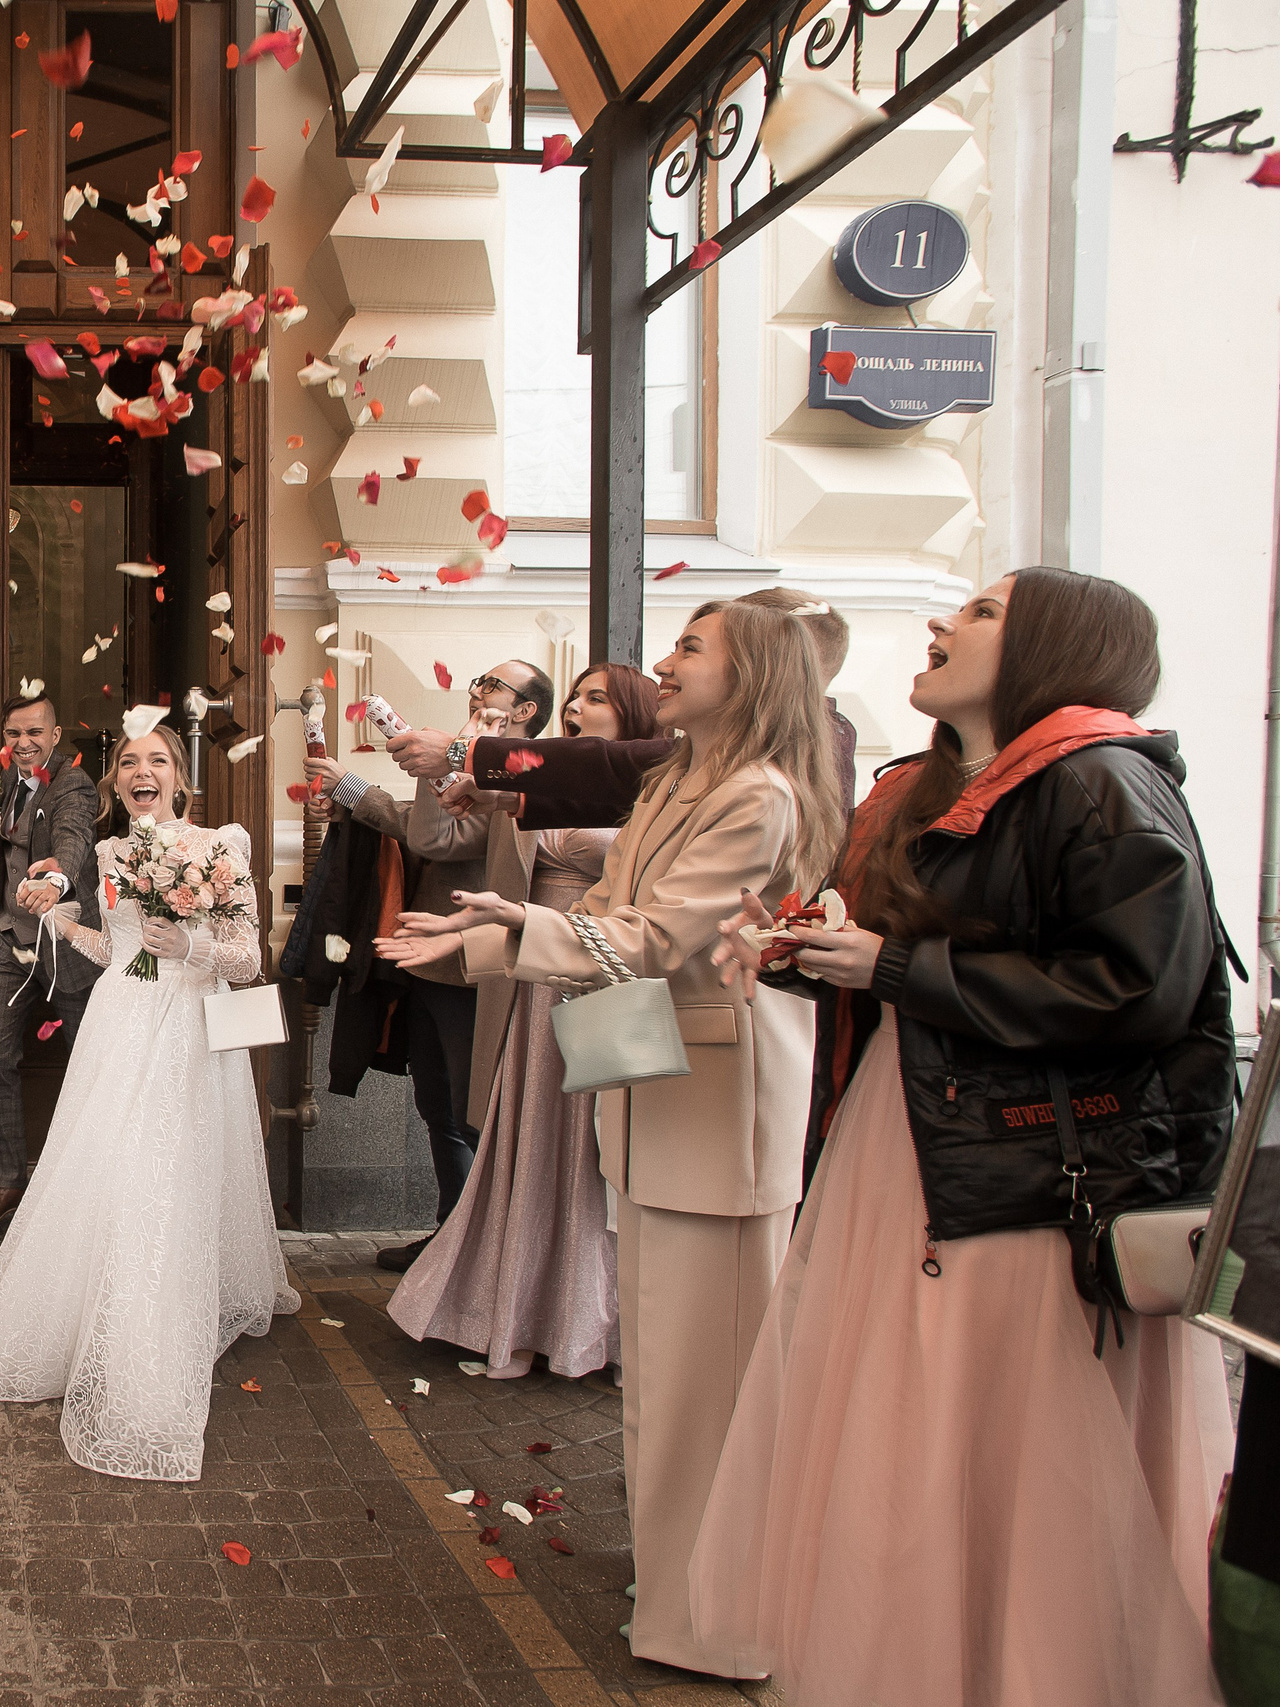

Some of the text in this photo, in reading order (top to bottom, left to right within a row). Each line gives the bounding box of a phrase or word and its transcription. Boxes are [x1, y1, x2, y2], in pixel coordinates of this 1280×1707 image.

[890, 229, 928, 269] 11
[854, 356, 985, 373] ОЩАДЬ ЛЕНИНА
[889, 400, 928, 411] УЛИЦА
